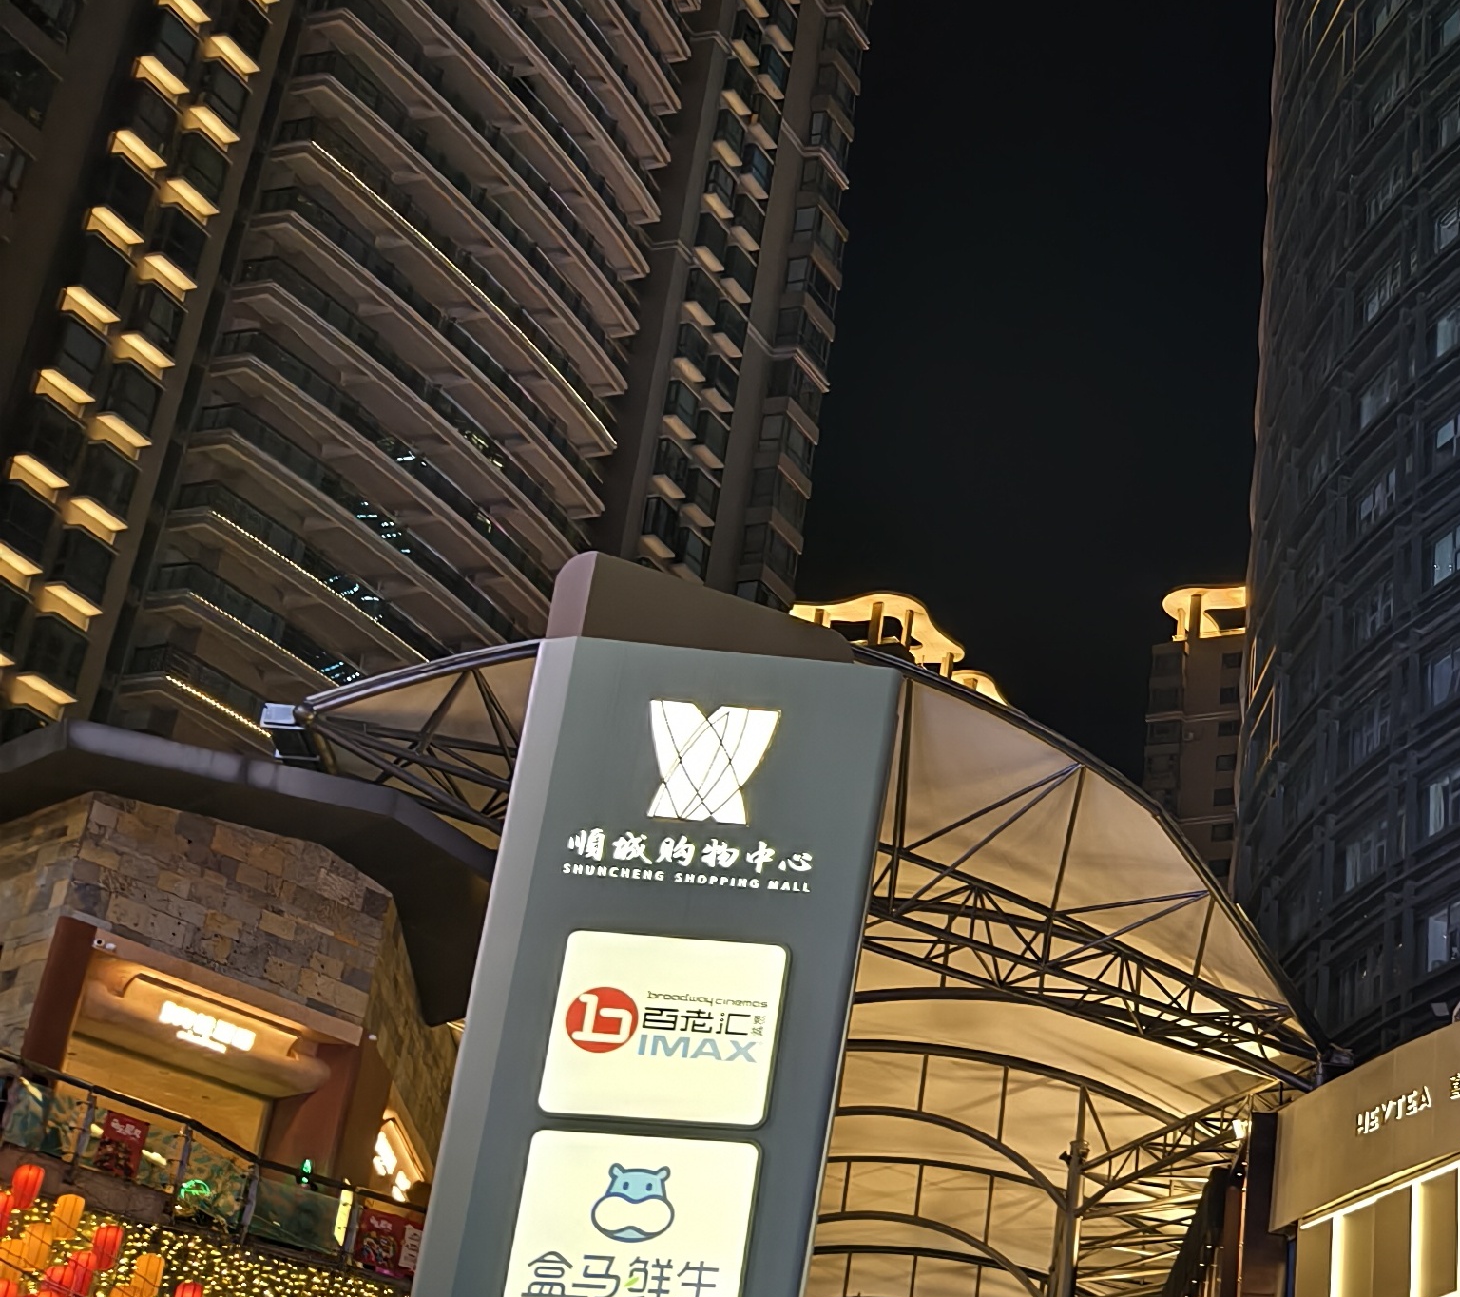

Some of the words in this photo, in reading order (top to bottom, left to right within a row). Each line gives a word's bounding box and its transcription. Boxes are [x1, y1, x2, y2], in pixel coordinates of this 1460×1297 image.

[562, 862, 665, 882] SHUNCHENG
[674, 872, 760, 890] SHOPPING
[766, 880, 812, 893] MALL
[646, 990, 713, 1007] broadway
[642, 1006, 752, 1036] 百老汇
[637, 1034, 758, 1063] IMAX
[1356, 1085, 1432, 1135] HEYTEA
